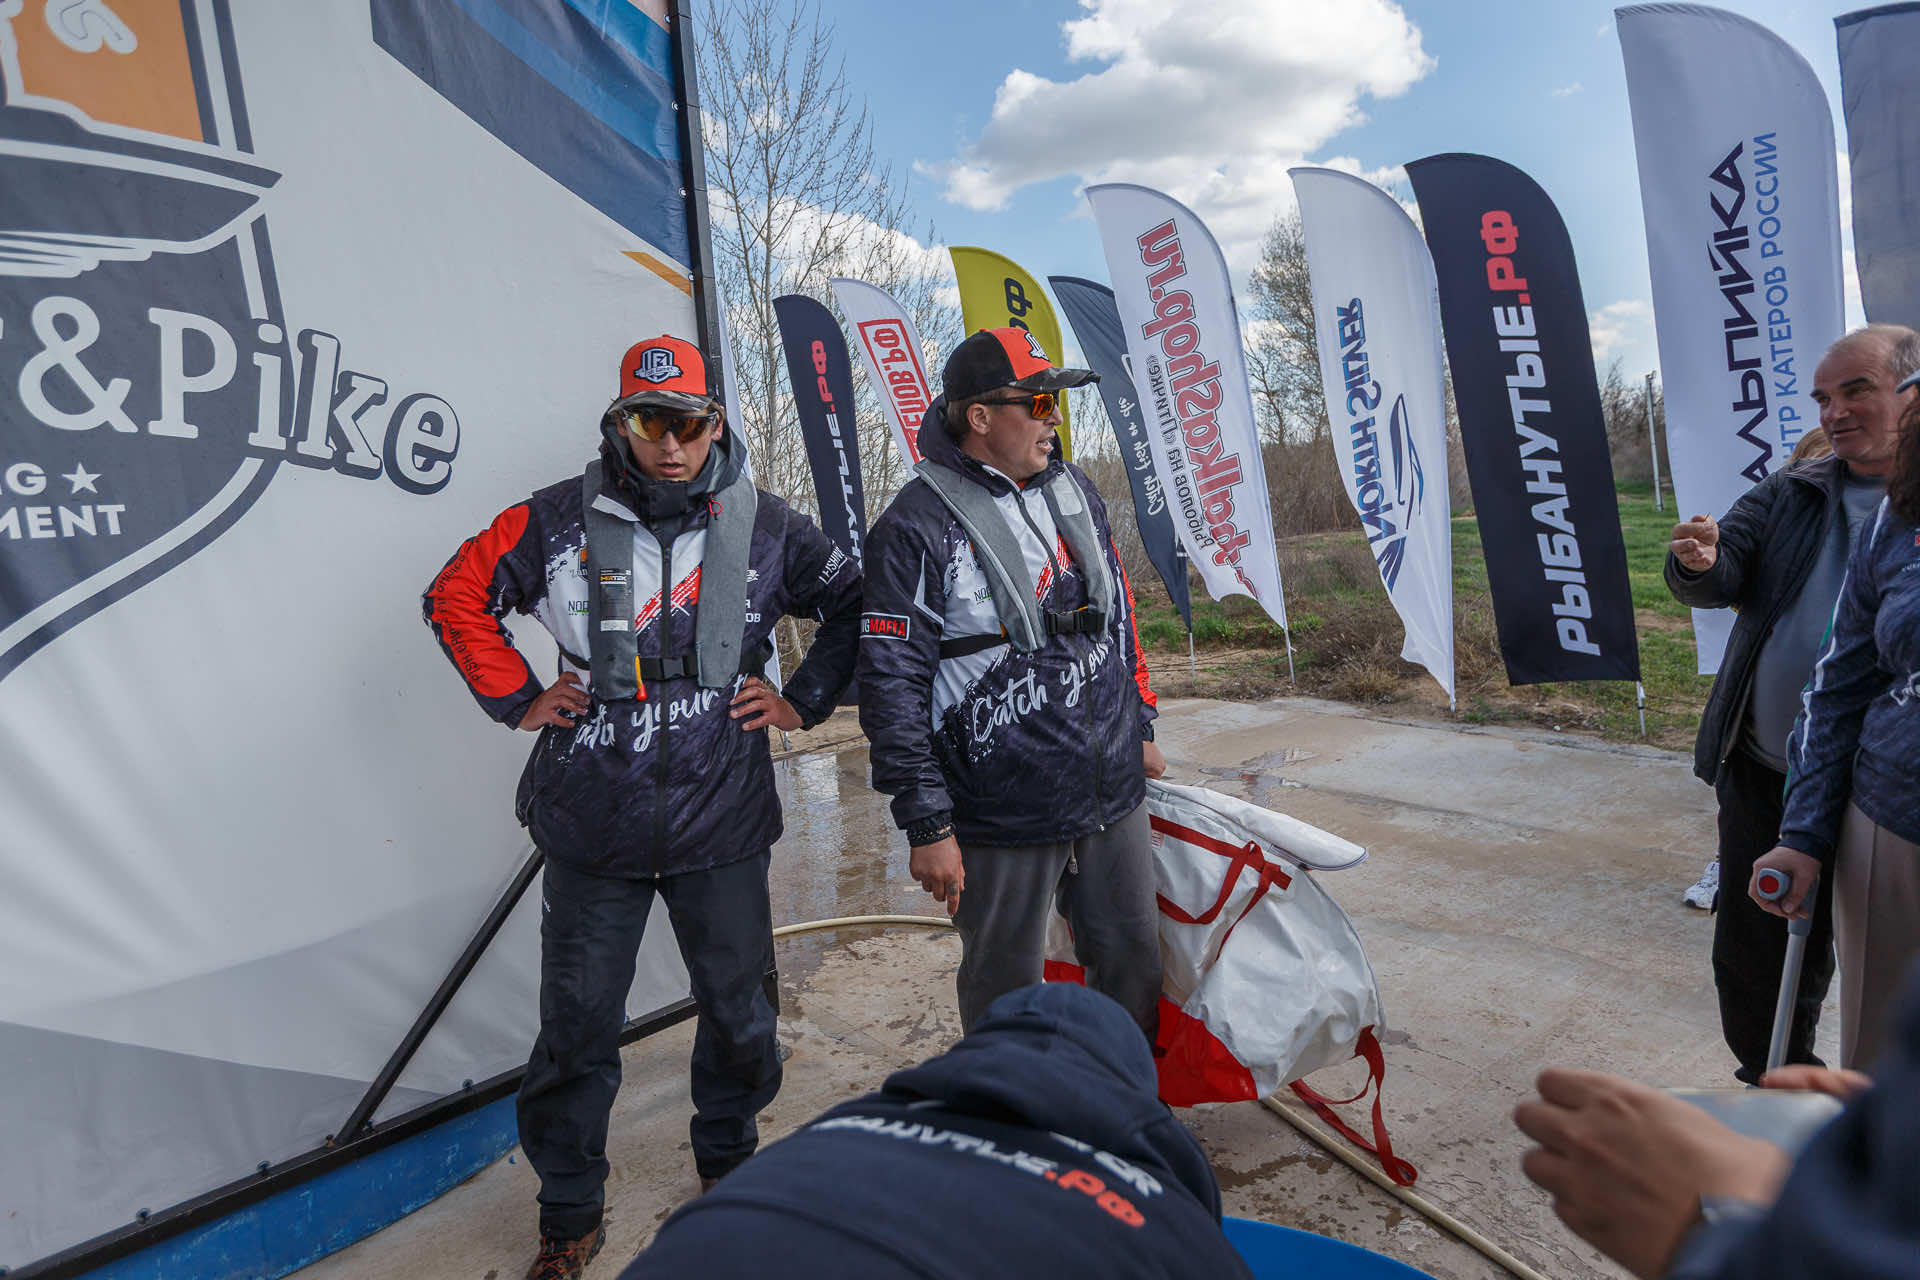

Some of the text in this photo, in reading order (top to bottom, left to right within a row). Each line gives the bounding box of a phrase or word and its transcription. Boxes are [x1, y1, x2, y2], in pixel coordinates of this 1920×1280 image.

[1706, 140, 1773, 484] АЛЬПИЙКА
[1752, 132, 1784, 258] РОССИИ
[1479, 209, 1601, 657] РЫБАНУТЫЕ.РФ
[1764, 265, 1798, 397] КАТЕРОВ
